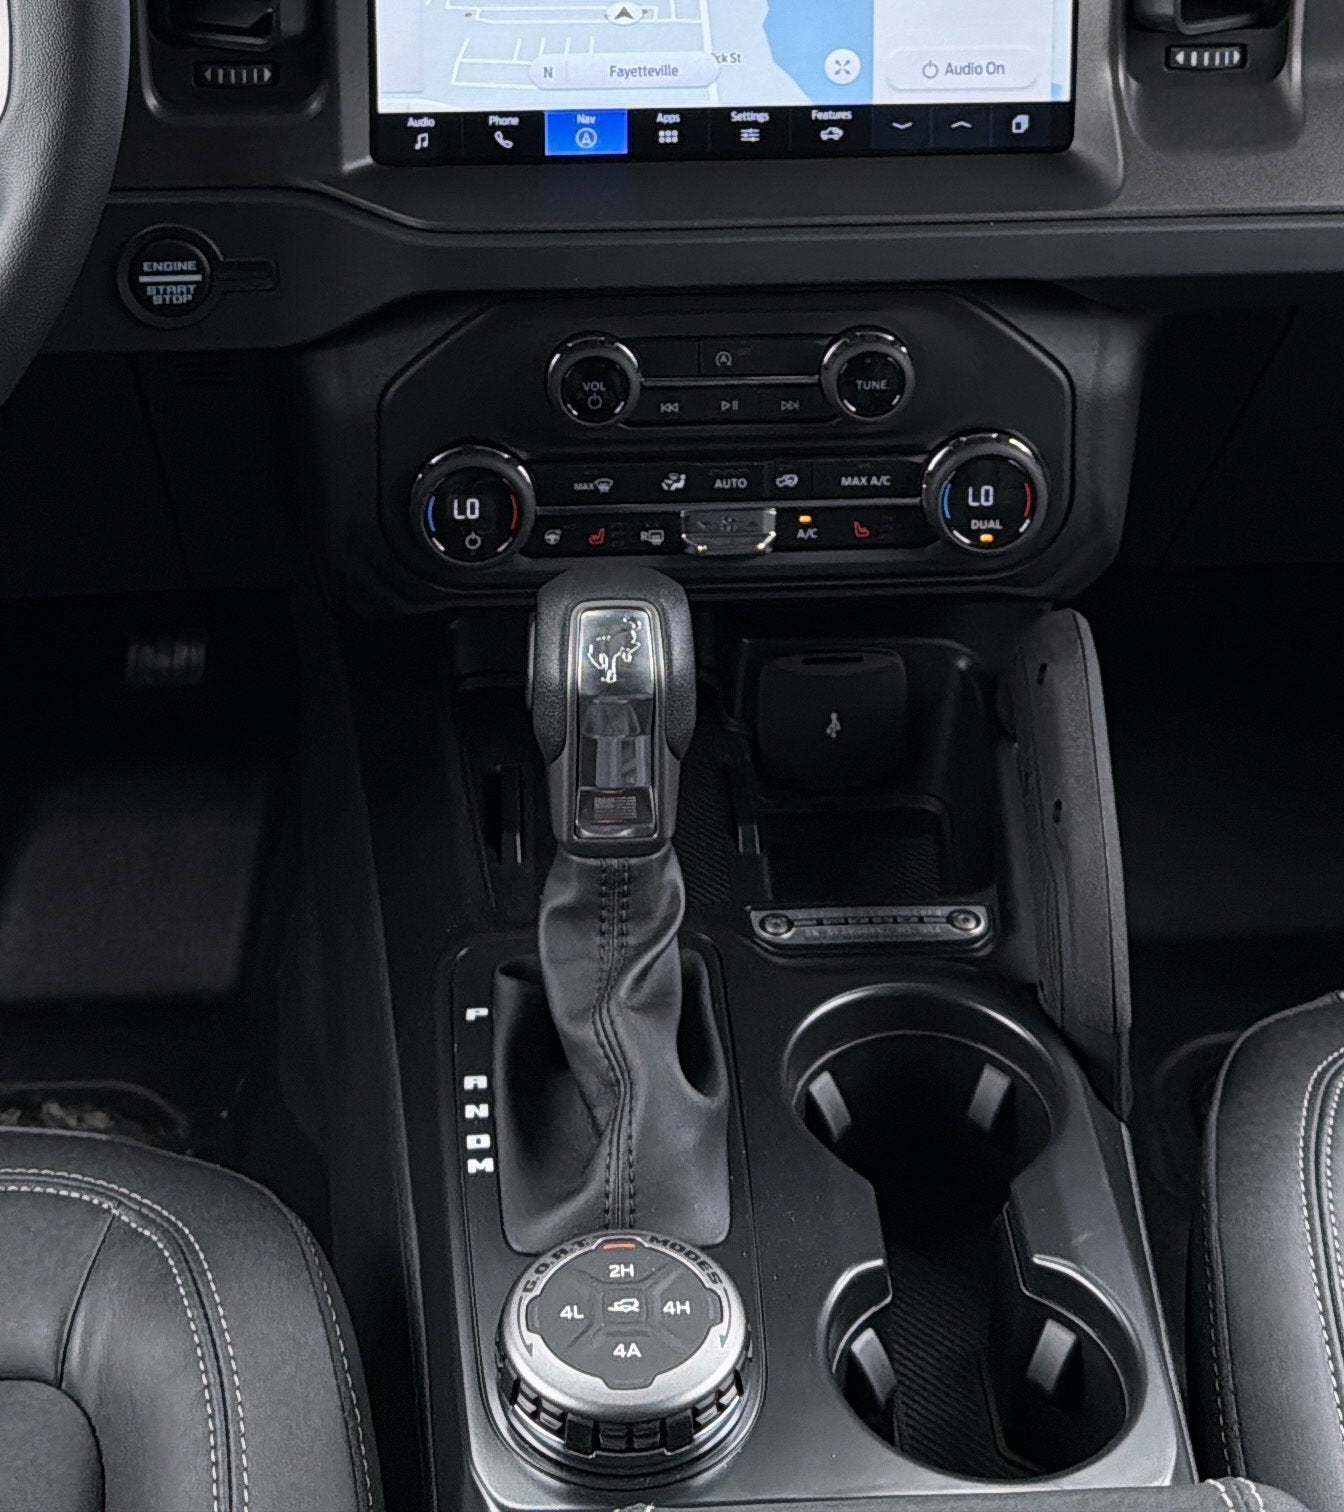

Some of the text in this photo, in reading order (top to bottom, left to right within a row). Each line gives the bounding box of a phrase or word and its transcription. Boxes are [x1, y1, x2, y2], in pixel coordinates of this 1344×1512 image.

[730, 52, 742, 64] St
[543, 67, 553, 78] N
[609, 65, 679, 80] Fayetteville
[944, 62, 1005, 76] Audio On
[407, 115, 435, 128] Audio
[488, 115, 519, 127] Phone
[576, 113, 595, 125] Nav
[656, 112, 680, 125] Apps
[730, 110, 770, 123] Settings
[811, 109, 852, 121] Features
[142, 261, 197, 272] ENGINE
[146, 285, 197, 296] START
[152, 294, 193, 304] STOP
[582, 381, 606, 391] VOL
[855, 379, 888, 390] TUNE
[714, 477, 748, 489] AUTO
[841, 474, 892, 487] MAX A/C
[967, 485, 995, 507] LO
[453, 498, 479, 520] LO
[970, 519, 1003, 530] DUAL
[796, 527, 818, 539] A/C
[466, 1007, 489, 1021] P
[464, 1103, 489, 1119] N
[466, 1133, 491, 1150] D
[467, 1157, 495, 1174] M
[647, 1235, 723, 1285] MODES
[608, 1263, 635, 1278] 2H
[559, 1305, 585, 1320] 4L
[662, 1300, 691, 1315] 4H
[613, 1343, 642, 1359] 4A
